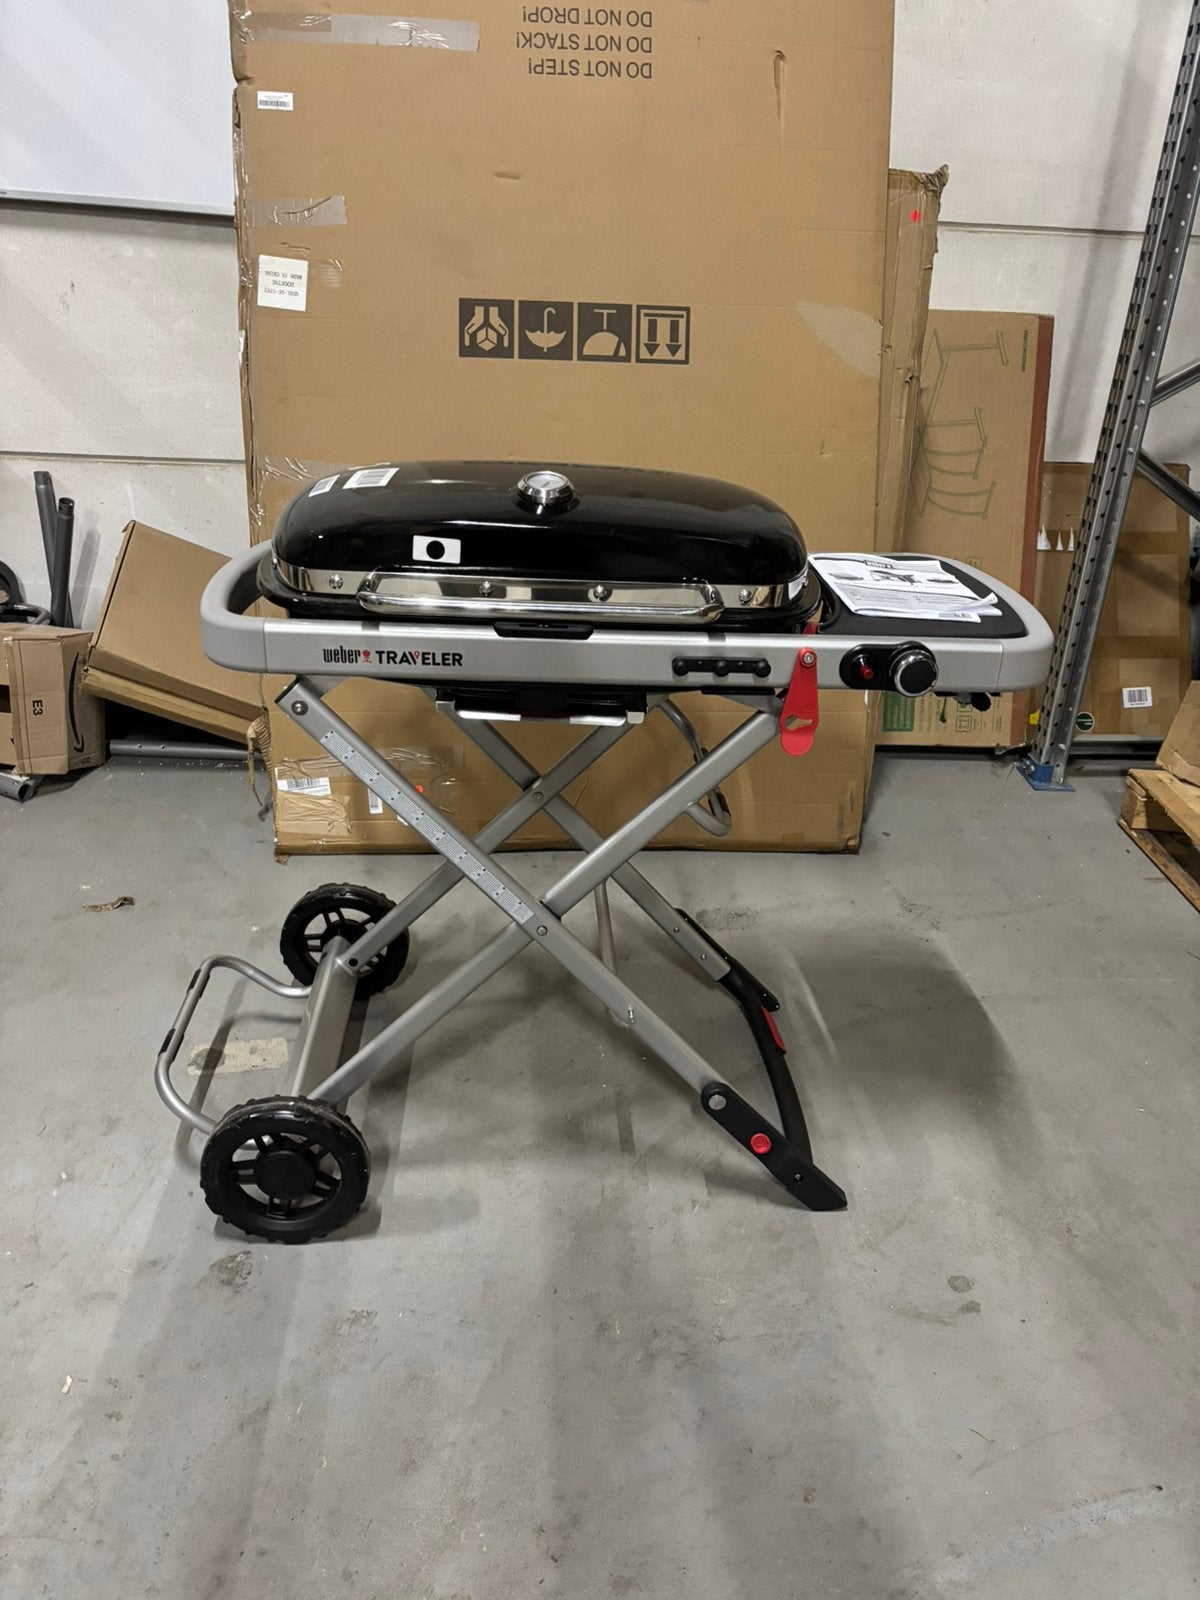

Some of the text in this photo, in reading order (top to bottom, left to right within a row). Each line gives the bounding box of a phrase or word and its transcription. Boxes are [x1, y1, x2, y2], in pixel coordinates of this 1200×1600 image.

[522, 6, 652, 28] DO NOT DROP!
[516, 31, 652, 53] DO NOT STACK!
[528, 58, 652, 79] DO NOT STEP!
[322, 645, 463, 667] weber TRAVELER
[32, 699, 44, 716] E3
